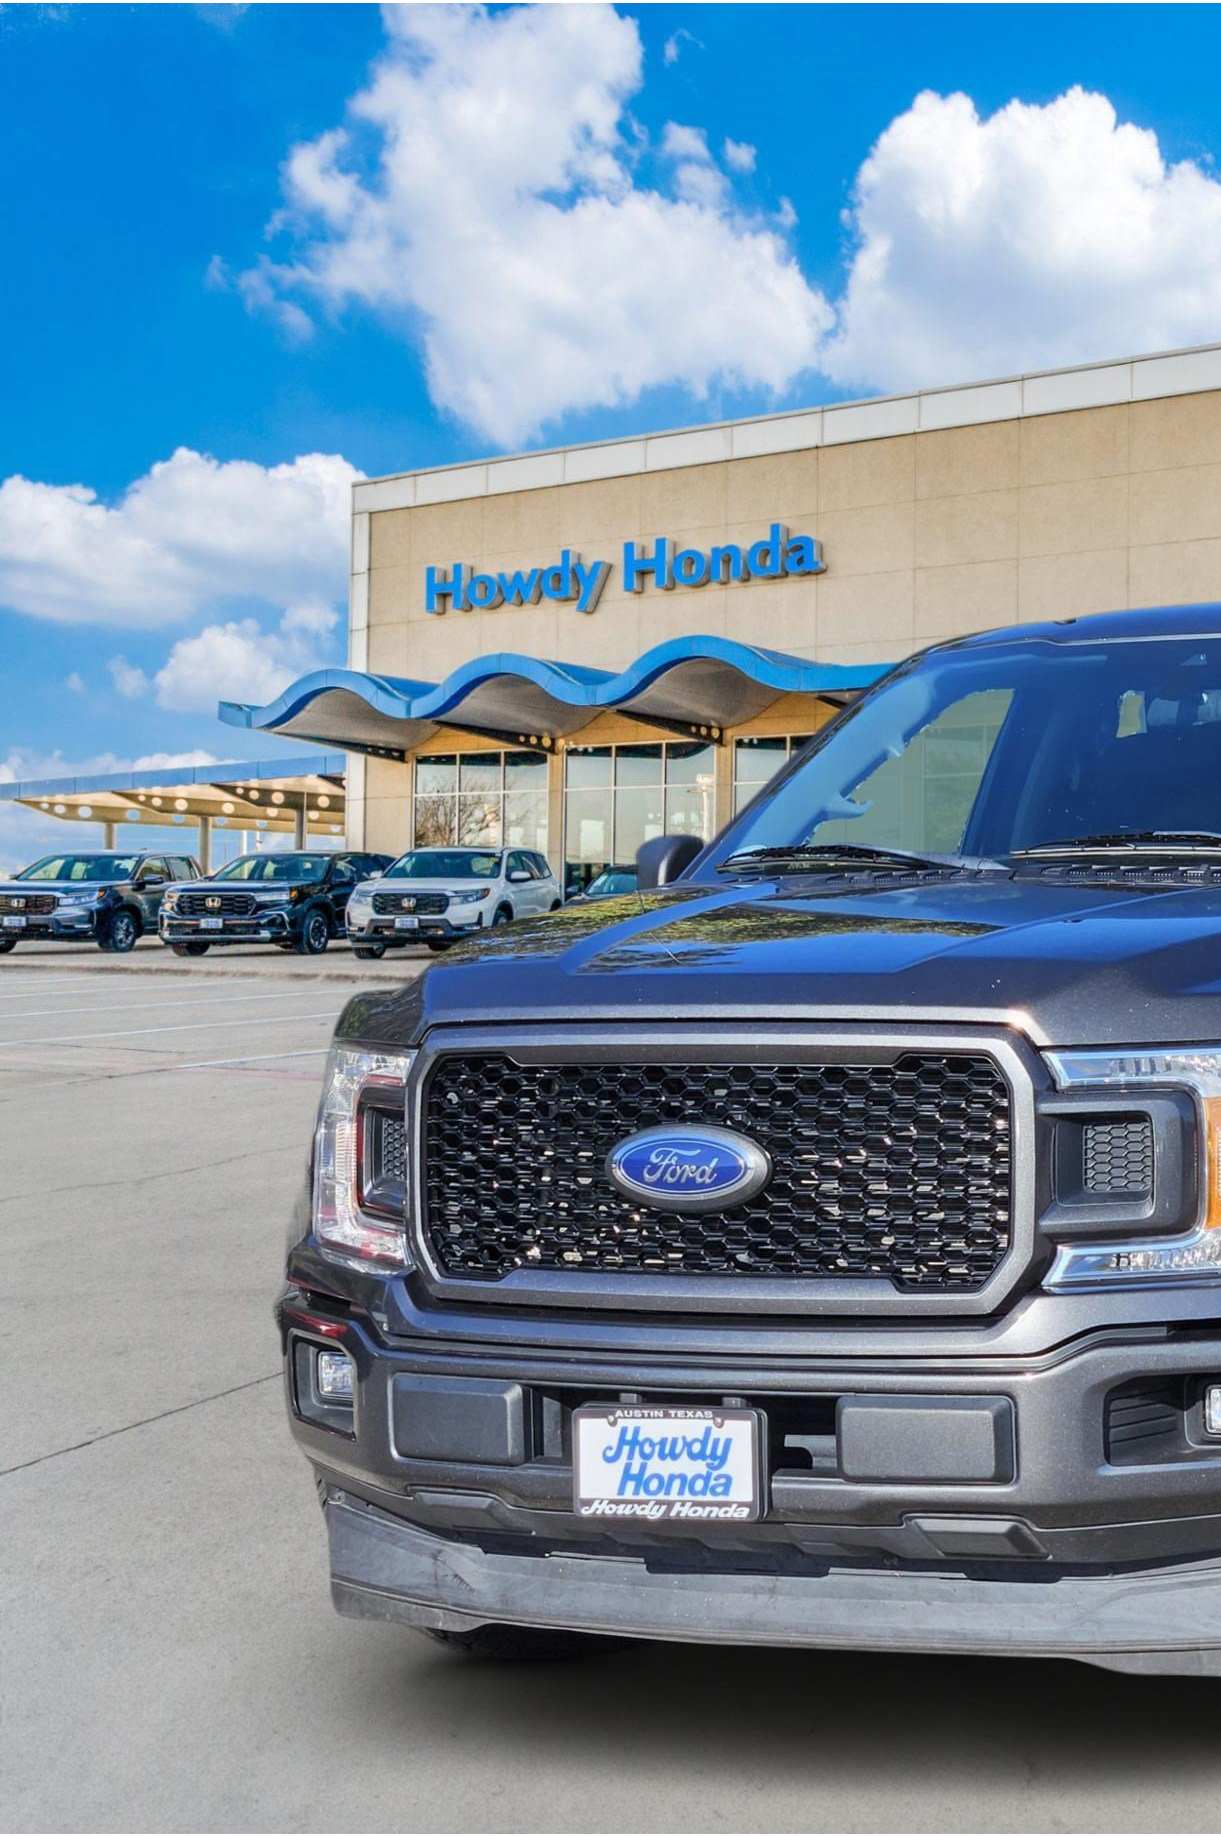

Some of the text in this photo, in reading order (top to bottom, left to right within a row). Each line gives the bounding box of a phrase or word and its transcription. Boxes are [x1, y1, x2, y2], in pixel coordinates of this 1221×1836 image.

[425, 523, 828, 615] Howdy Honda
[643, 1147, 719, 1184] Ford
[615, 1409, 713, 1419] AUSTIN TEXAS
[602, 1425, 733, 1472] Howdy
[617, 1462, 733, 1497] Honda
[581, 1500, 751, 1519] Howdy Honda
